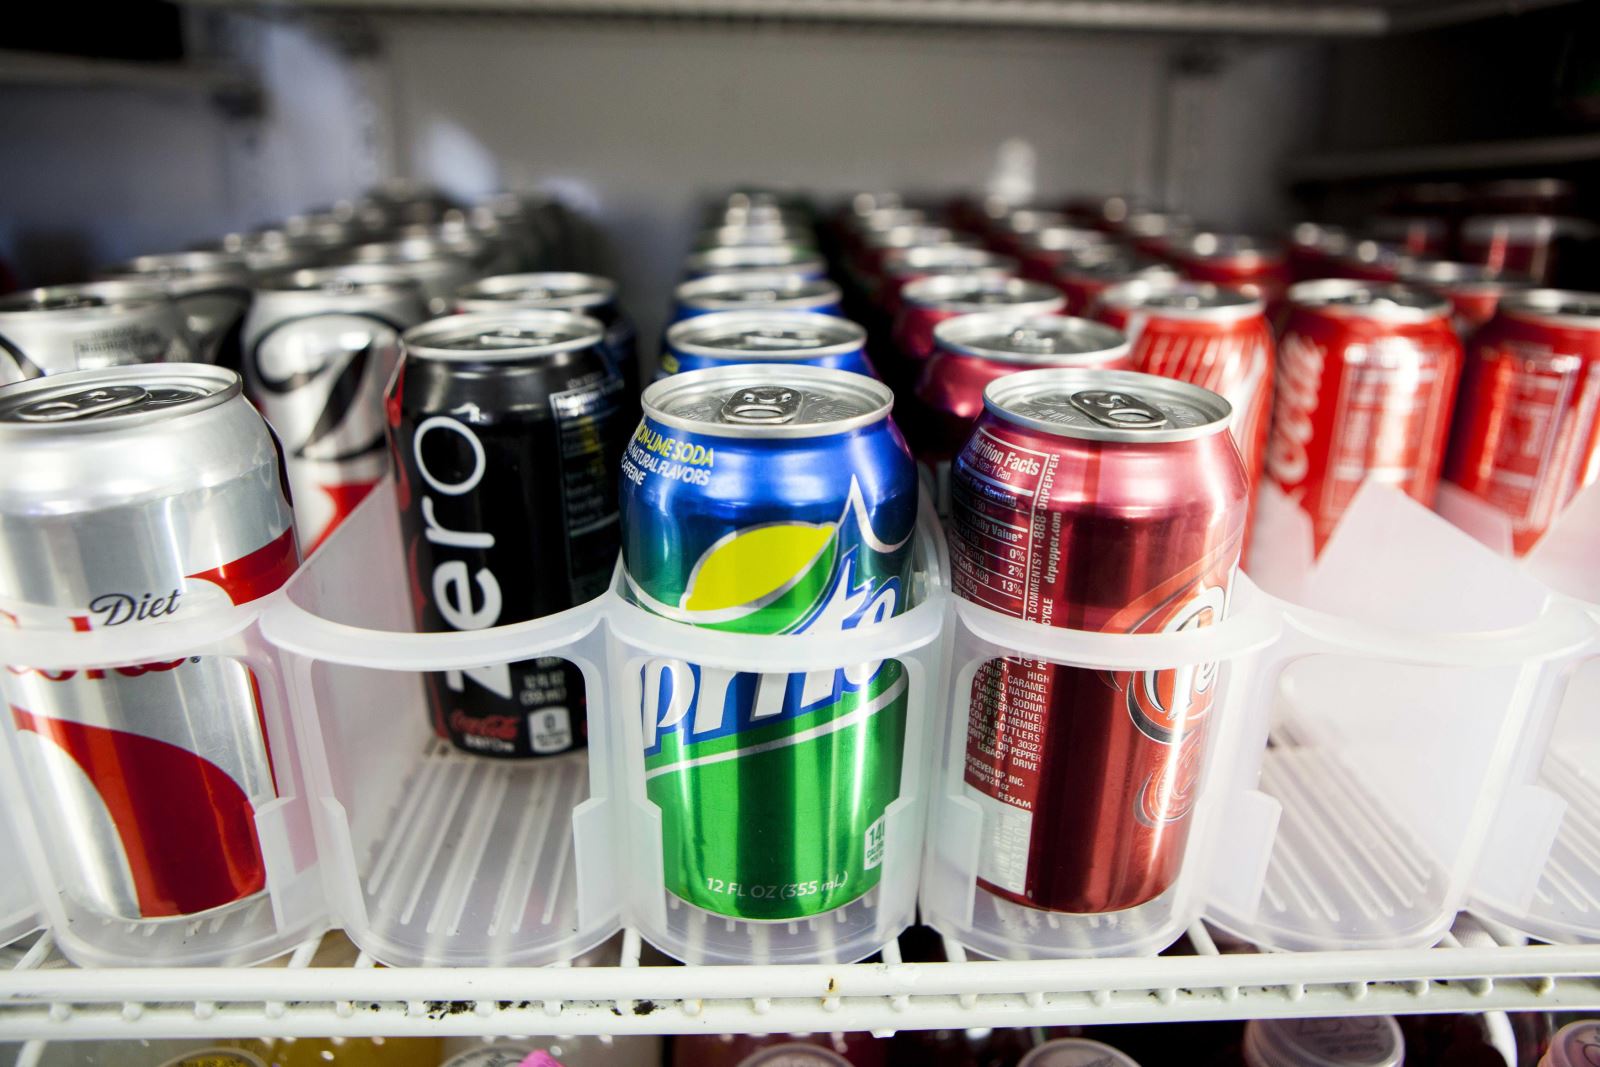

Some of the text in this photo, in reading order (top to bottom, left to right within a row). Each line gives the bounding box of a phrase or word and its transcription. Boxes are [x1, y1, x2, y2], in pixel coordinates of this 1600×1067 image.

[671, 441, 714, 468] SODA
[1003, 451, 1041, 476] Facts
[658, 460, 711, 486] FLAVORS
[996, 466, 1012, 481] Can
[984, 484, 1017, 507] Serving
[1009, 548, 1026, 562] 0%
[1043, 512, 1063, 584] drpepper.com
[1008, 564, 1024, 579] 2%
[1028, 551, 1042, 613] COMMENTS?
[975, 570, 990, 584] 40g
[1001, 579, 1023, 595] 13%
[89, 588, 182, 627] Diet
[1007, 675, 1049, 694] CARAMEL
[1027, 670, 1049, 684] HIGH
[1008, 685, 1047, 703] NATURAL
[994, 720, 1041, 742] BOTTLERS
[1008, 716, 1045, 734] MEMBER
[998, 741, 1009, 752] DR
[1011, 747, 1042, 762] PEPPER
[1002, 734, 1014, 745] GA
[1018, 739, 1042, 753] 30327
[977, 742, 1038, 771] LEGACY DRIVE
[1008, 775, 1025, 787] INC.
[998, 791, 1032, 809] REXAM
[706, 870, 849, 900] 12 FL OZ (355 mL)
